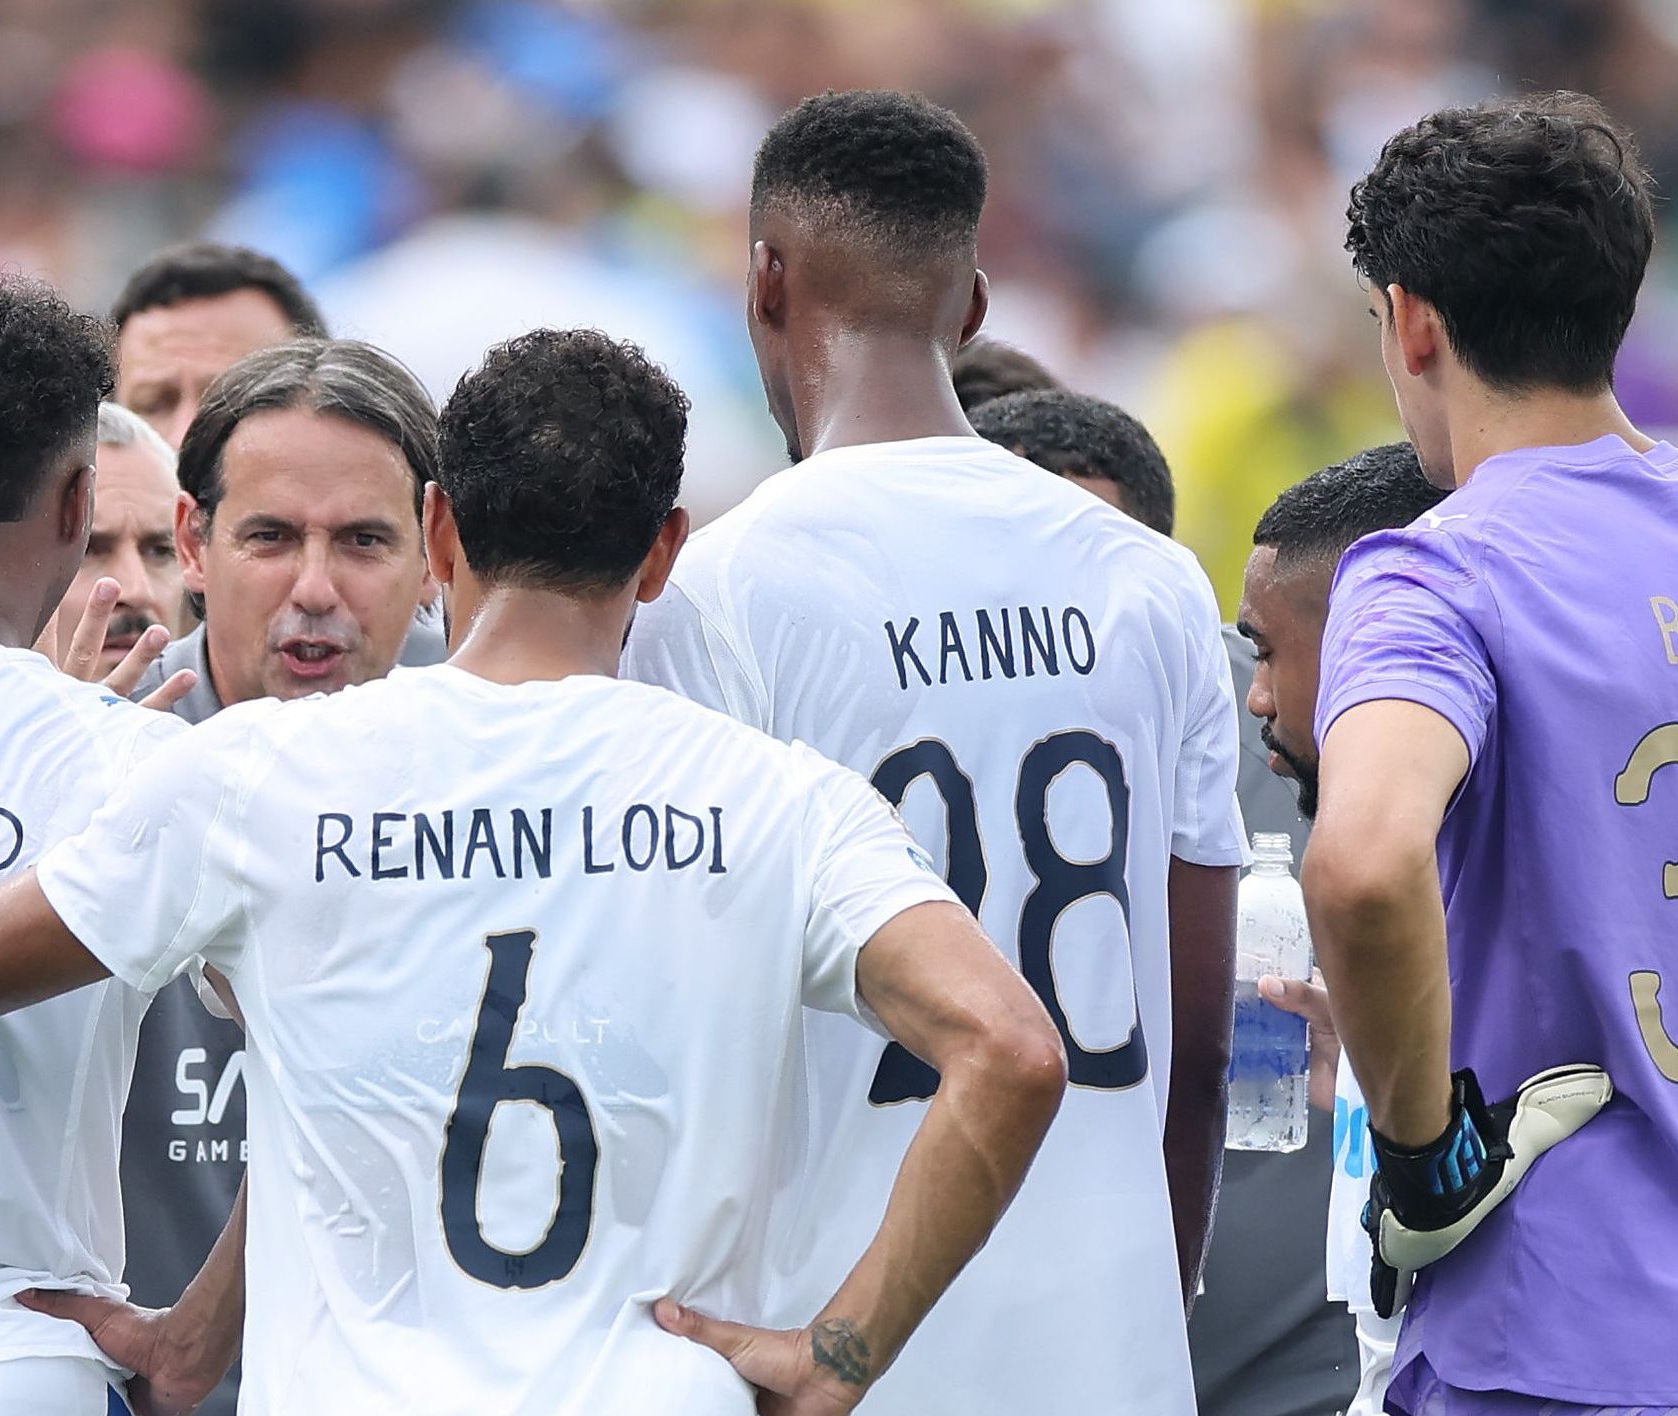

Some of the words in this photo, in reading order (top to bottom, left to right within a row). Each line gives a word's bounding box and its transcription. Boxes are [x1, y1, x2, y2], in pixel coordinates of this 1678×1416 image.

[884, 605, 1097, 690] KANNO
[314, 807, 553, 882] RENAN
[582, 803, 728, 876] LODI
[867, 728, 1149, 1108] 28
[437, 926, 600, 1293] 6
